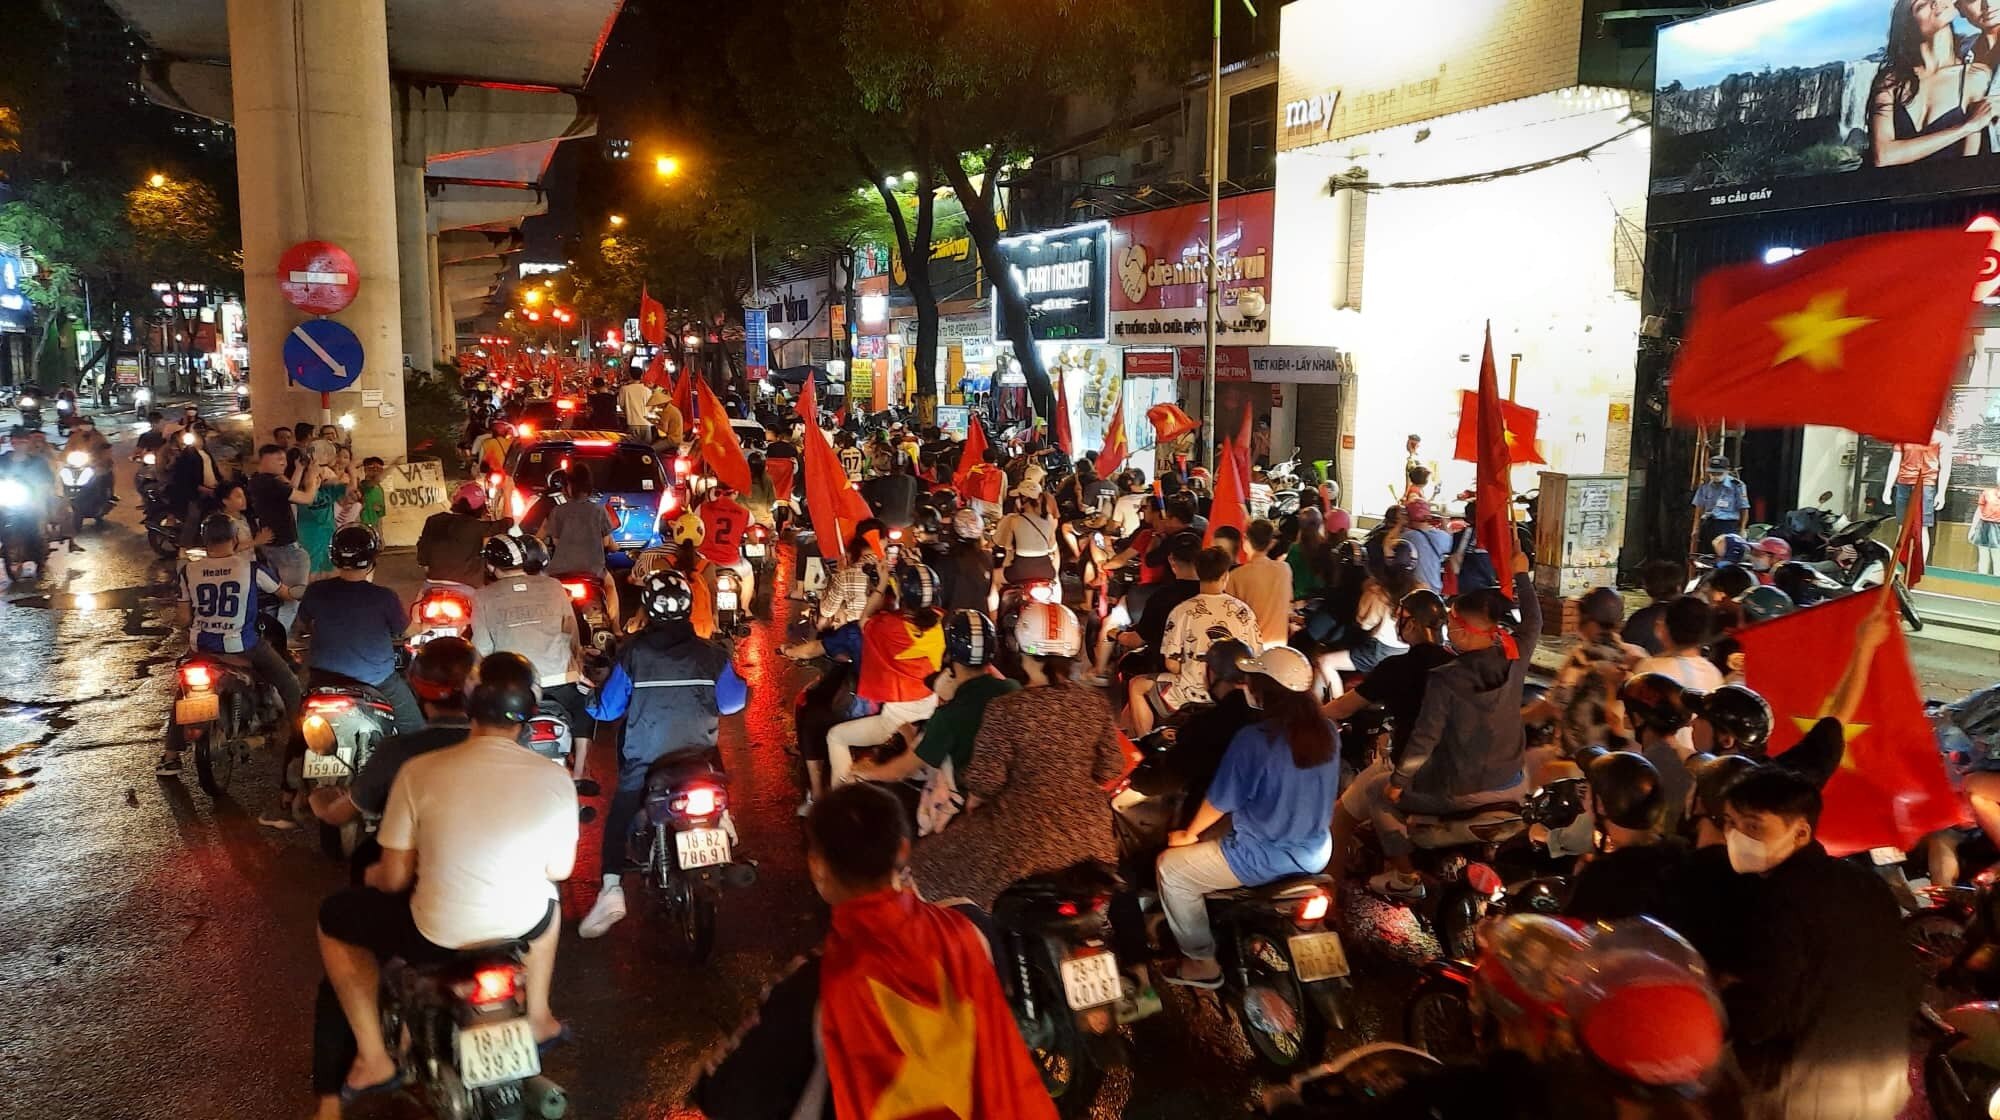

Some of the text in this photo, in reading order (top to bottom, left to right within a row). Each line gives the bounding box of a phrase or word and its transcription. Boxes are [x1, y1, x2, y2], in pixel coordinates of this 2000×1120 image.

[1285, 90, 1341, 130] may
[1710, 195, 1726, 205] 355
[844, 456, 859, 470] 07
[715, 518, 732, 545] 2
[203, 568, 232, 577] Healer
[196, 581, 241, 617] 96
[308, 763, 346, 776] 159.02
